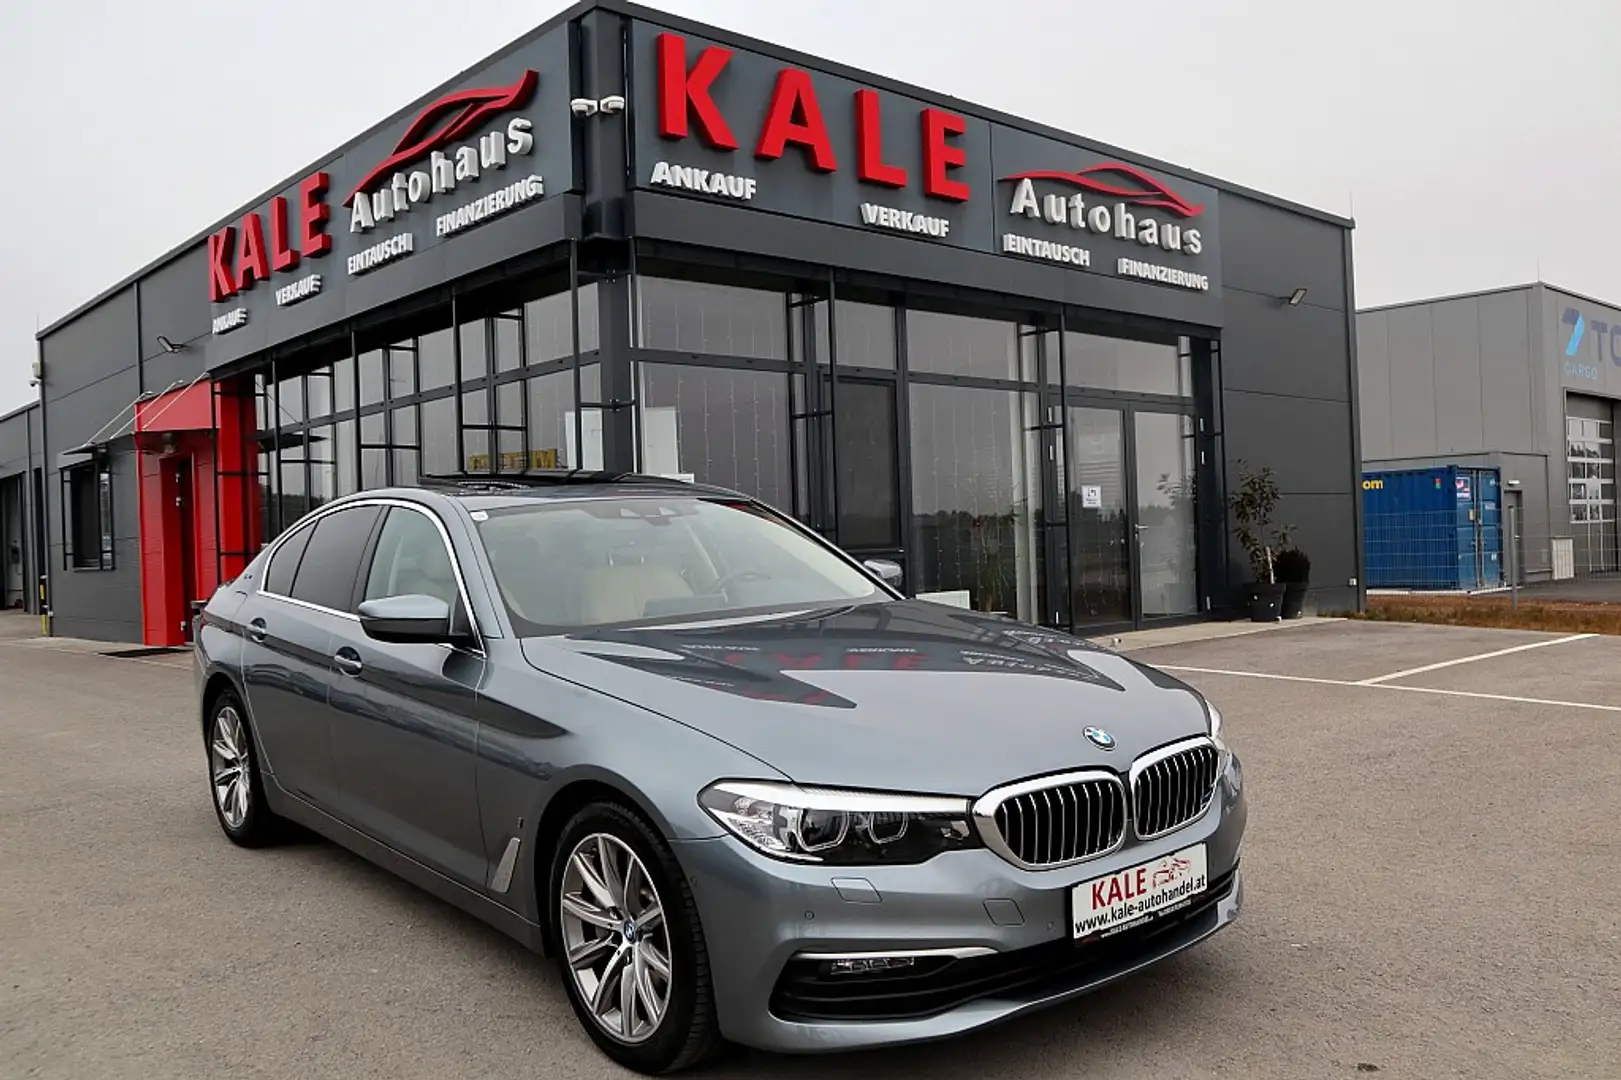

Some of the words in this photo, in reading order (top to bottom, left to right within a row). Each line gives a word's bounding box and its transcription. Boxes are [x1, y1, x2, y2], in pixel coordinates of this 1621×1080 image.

[349, 116, 533, 233] Autohaus
[656, 31, 970, 202] KALE
[207, 171, 332, 303] KALE
[275, 273, 321, 306] VERKAUF
[347, 232, 413, 275] EINTAUSCH
[436, 174, 544, 237] FINANZIERUNG
[650, 161, 757, 200] ANKAUF
[860, 203, 950, 238] VERKAUF
[1002, 233, 1090, 267] EINTAUSCH
[1117, 257, 1209, 291] FINANZIERUNG
[1009, 177, 1202, 255] Autohaus
[1563, 361, 1598, 380] CARGO
[1074, 873, 1206, 934] www.kale-autohandel.at
[1091, 867, 1148, 910] KALE
